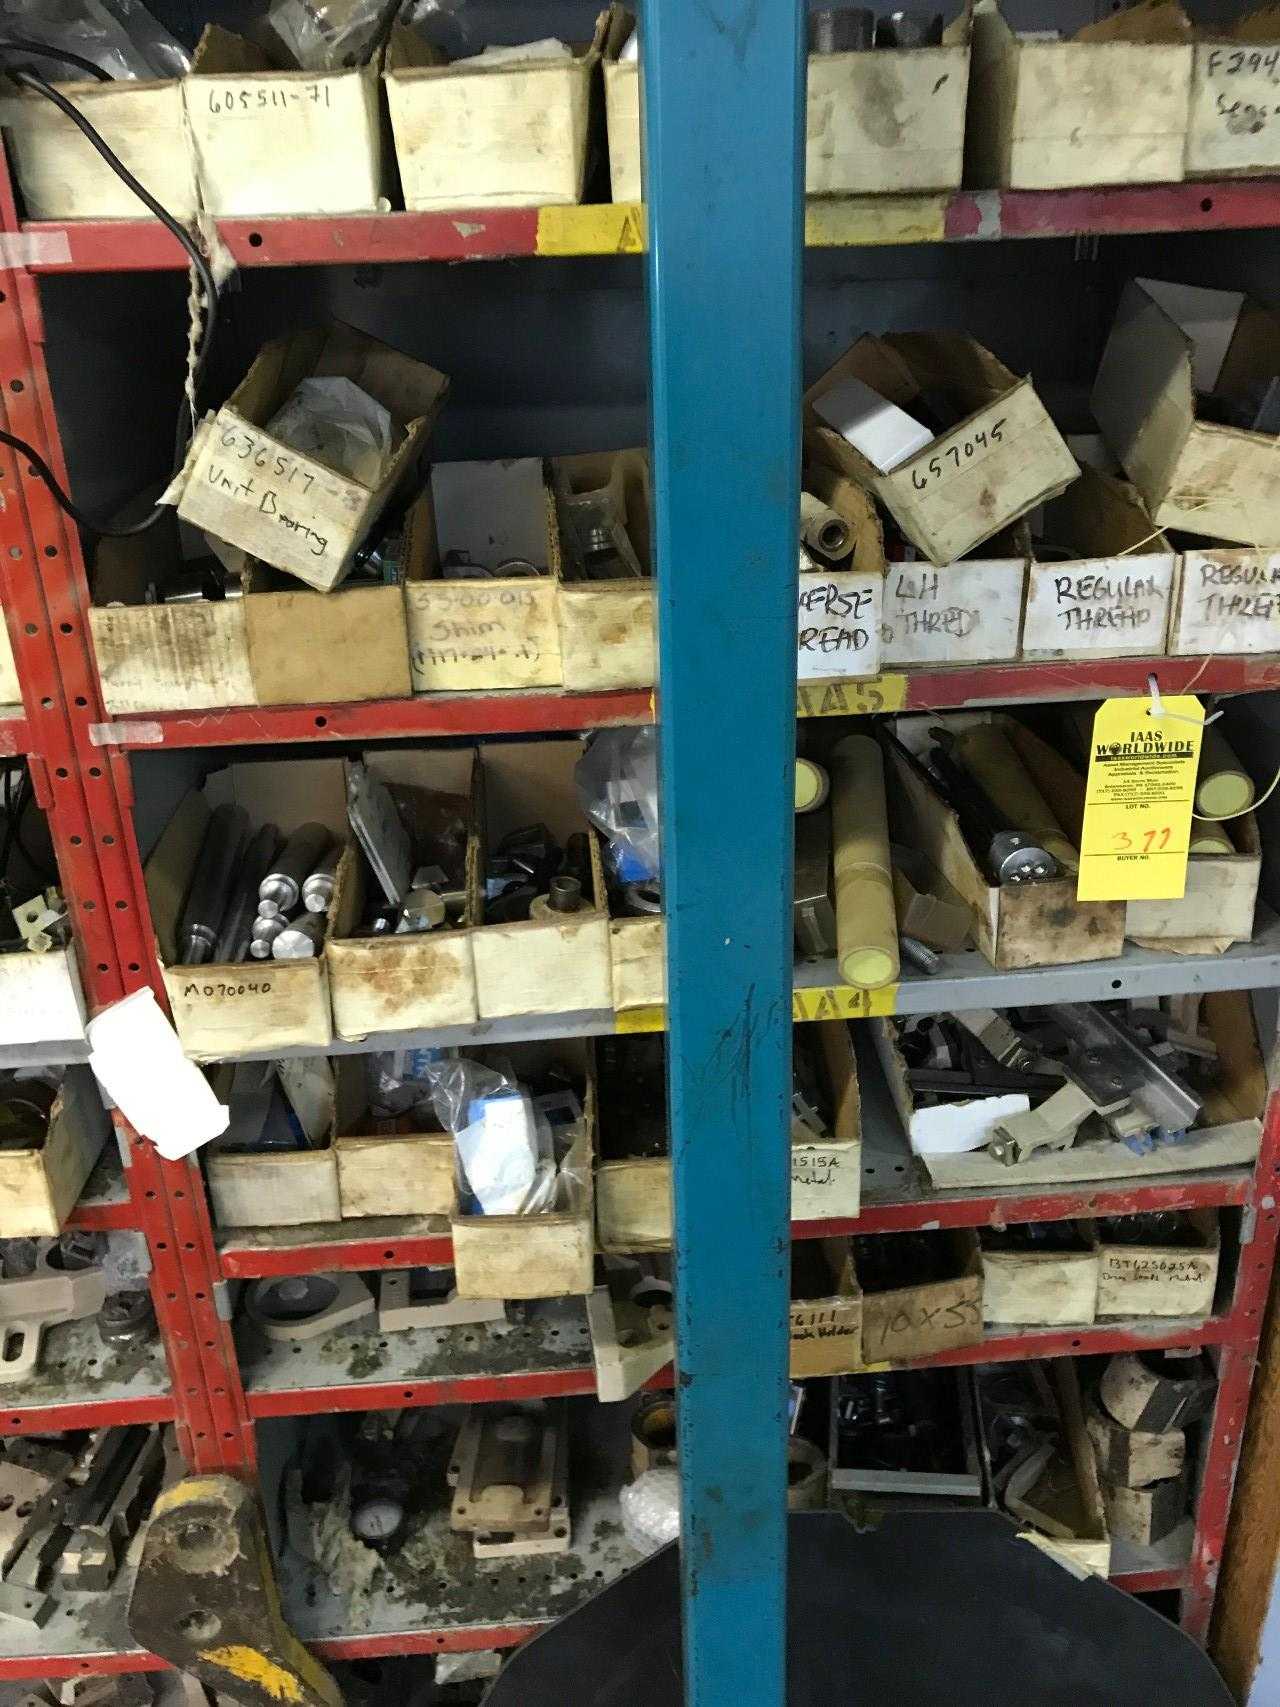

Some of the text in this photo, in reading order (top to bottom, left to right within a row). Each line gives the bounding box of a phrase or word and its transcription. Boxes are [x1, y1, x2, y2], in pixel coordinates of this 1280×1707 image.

[208, 84, 330, 113] 605511-71
[912, 418, 1008, 490] 657045
[1130, 730, 1164, 743] IAAS
[1096, 740, 1195, 756] WORLDWIDE
